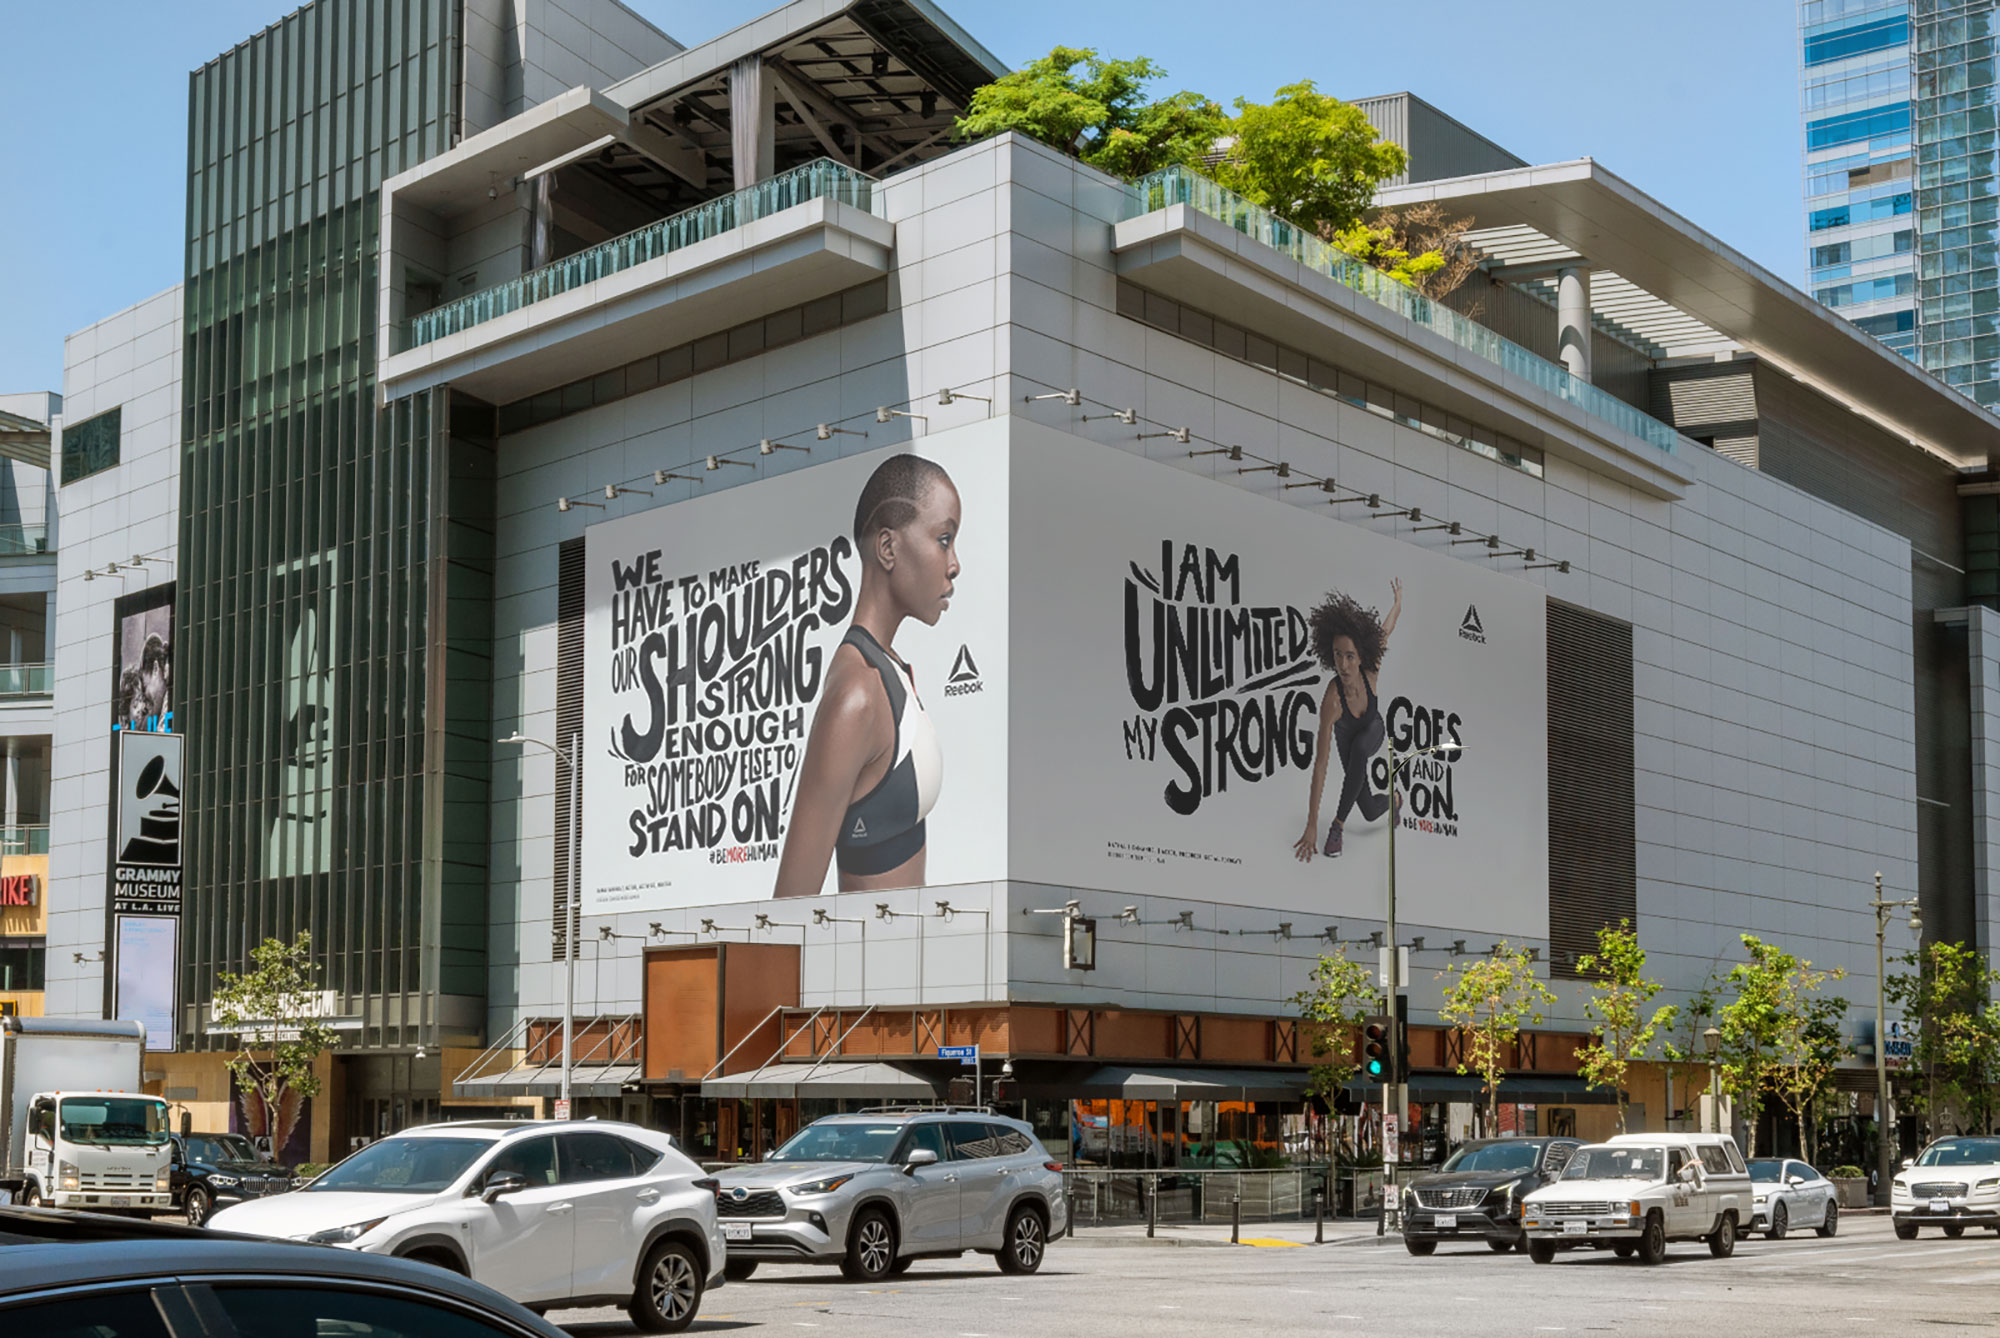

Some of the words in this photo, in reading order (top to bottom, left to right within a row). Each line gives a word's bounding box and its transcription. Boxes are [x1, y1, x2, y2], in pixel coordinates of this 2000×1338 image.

[612, 550, 663, 591] WE
[1161, 539, 1173, 600] I
[1175, 543, 1240, 605] AM
[612, 580, 674, 650] HAVE
[679, 575, 706, 616] TO
[709, 560, 760, 602] MAKE
[612, 647, 640, 694] OUR
[621, 535, 852, 763] SHOULDERS
[697, 612, 822, 719] STRONG
[944, 681, 984, 697] Reebok
[665, 707, 804, 759] ENOUGH
[1123, 715, 1157, 761] MY
[1161, 689, 1317, 815] STRONG
[1386, 696, 1462, 763] GOES
[625, 764, 646, 787] FOR
[647, 751, 738, 818] SOMEBODY
[740, 748, 772, 788] ELSE
[777, 743, 796, 775] TO
[1371, 752, 1411, 792] ON
[1413, 757, 1445, 783] AND
[629, 802, 727, 858] STAND
[0, 874, 31, 905] IKE
[114, 882, 180, 899] MUSEUM
[115, 867, 181, 883] GRAMMY
[114, 902, 128, 910] AT
[131, 903, 153, 911] L.A.
[157, 904, 180, 912] LIVE
